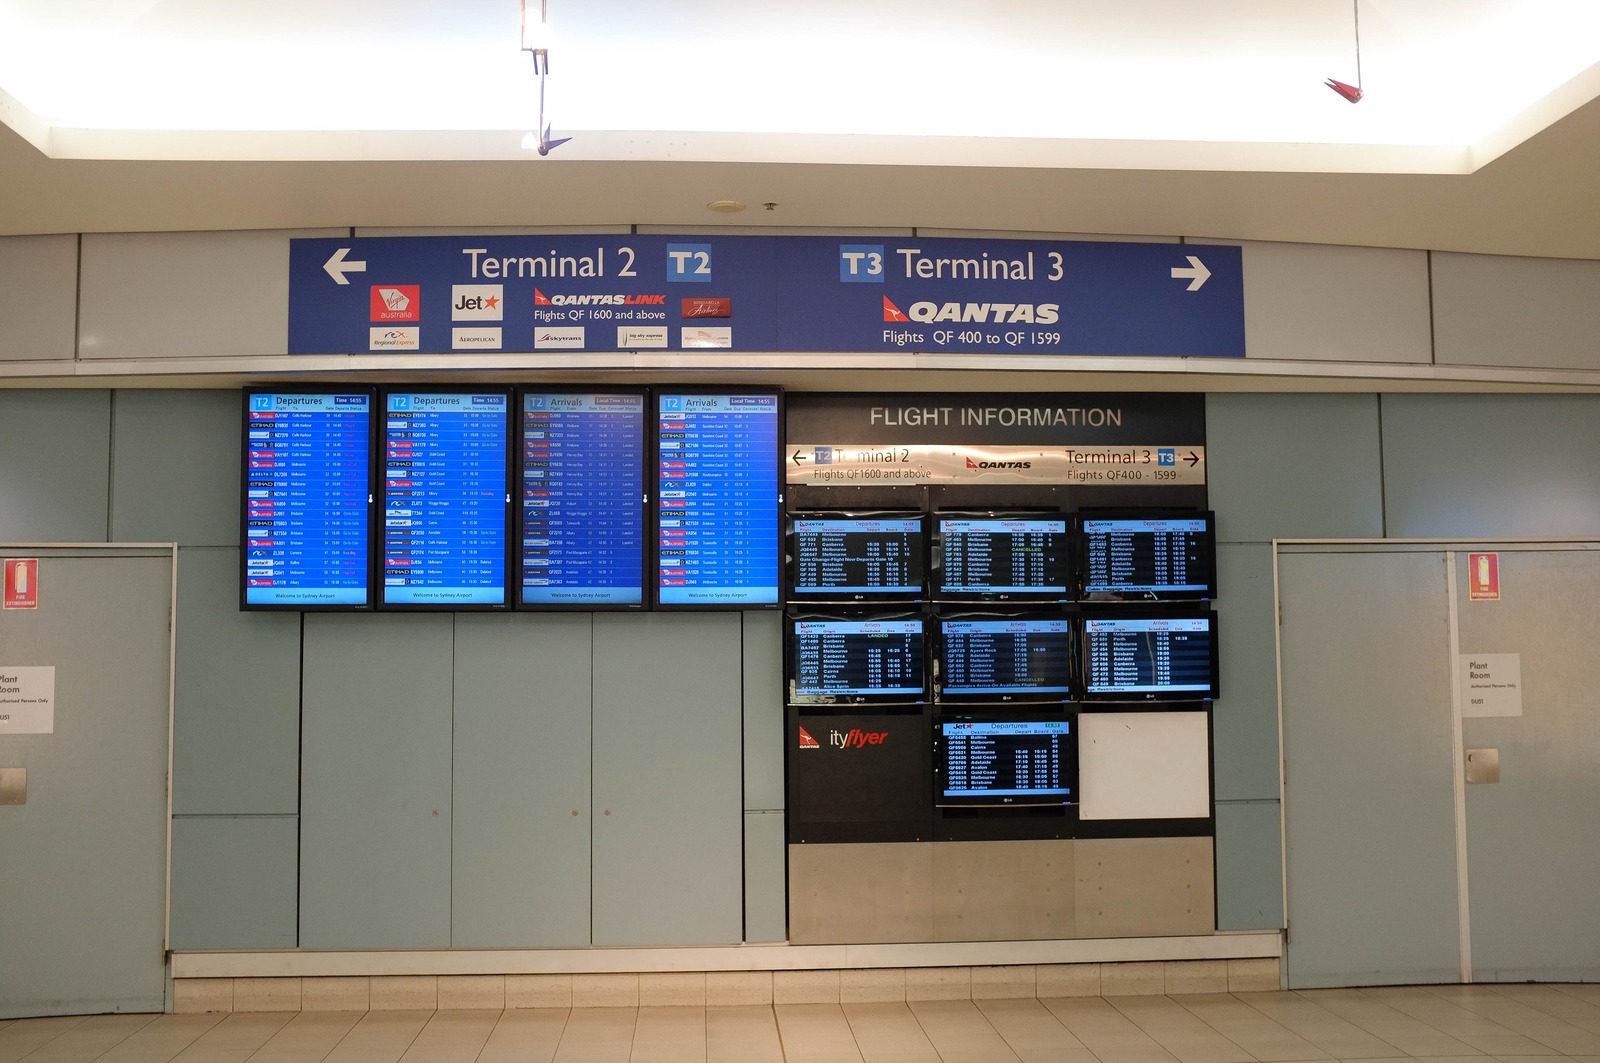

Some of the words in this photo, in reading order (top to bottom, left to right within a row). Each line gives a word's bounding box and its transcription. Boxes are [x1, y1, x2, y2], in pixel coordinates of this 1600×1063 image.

[462, 247, 604, 278] Terminal
[617, 247, 637, 277] 2
[669, 250, 711, 274] T2
[842, 252, 883, 275] T3
[896, 248, 1033, 280] Terminal
[1048, 252, 1063, 281] 3
[386, 292, 405, 309] Virgin
[455, 295, 482, 310] Jet
[380, 311, 412, 319] australia
[534, 309, 566, 321] Flights
[569, 309, 585, 321] QF
[588, 309, 612, 320] 1600
[615, 309, 633, 320] and
[635, 309, 666, 320] above
[909, 300, 1059, 324] QANTAS
[883, 329, 924, 345] Flights
[933, 331, 953, 345] QF
[958, 331, 982, 344] 400
[986, 332, 1000, 344] to
[1004, 331, 1025, 346] QF
[1030, 332, 1060, 345] 1599
[256, 398, 269, 407] T2
[276, 397, 323, 407] Departures
[394, 398, 406, 407] T2
[414, 397, 460, 407] Departures
[530, 398, 543, 407] T2
[551, 398, 583, 406] Arrivals
[665, 399, 678, 408] T2
[686, 399, 718, 407] Arrivals
[870, 407, 952, 426] FLIGHT
[961, 408, 1122, 427] INFORMATION
[815, 450, 832, 461] T2
[901, 448, 909, 462] 2
[1065, 449, 1136, 465] Terminal
[1142, 450, 1151, 464] 3
[1159, 452, 1174, 462] T3
[978, 461, 1032, 469] QANTAS
[814, 469, 844, 481] Flights
[847, 469, 881, 479] QF1600
[884, 469, 901, 479] and
[903, 469, 931, 479] above
[1067, 470, 1102, 481] Flights
[1105, 470, 1142, 481] QF400
[1153, 470, 1176, 480] 1599
[1469, 662, 1488, 670] Plant
[830, 728, 888, 749] ityflyer
